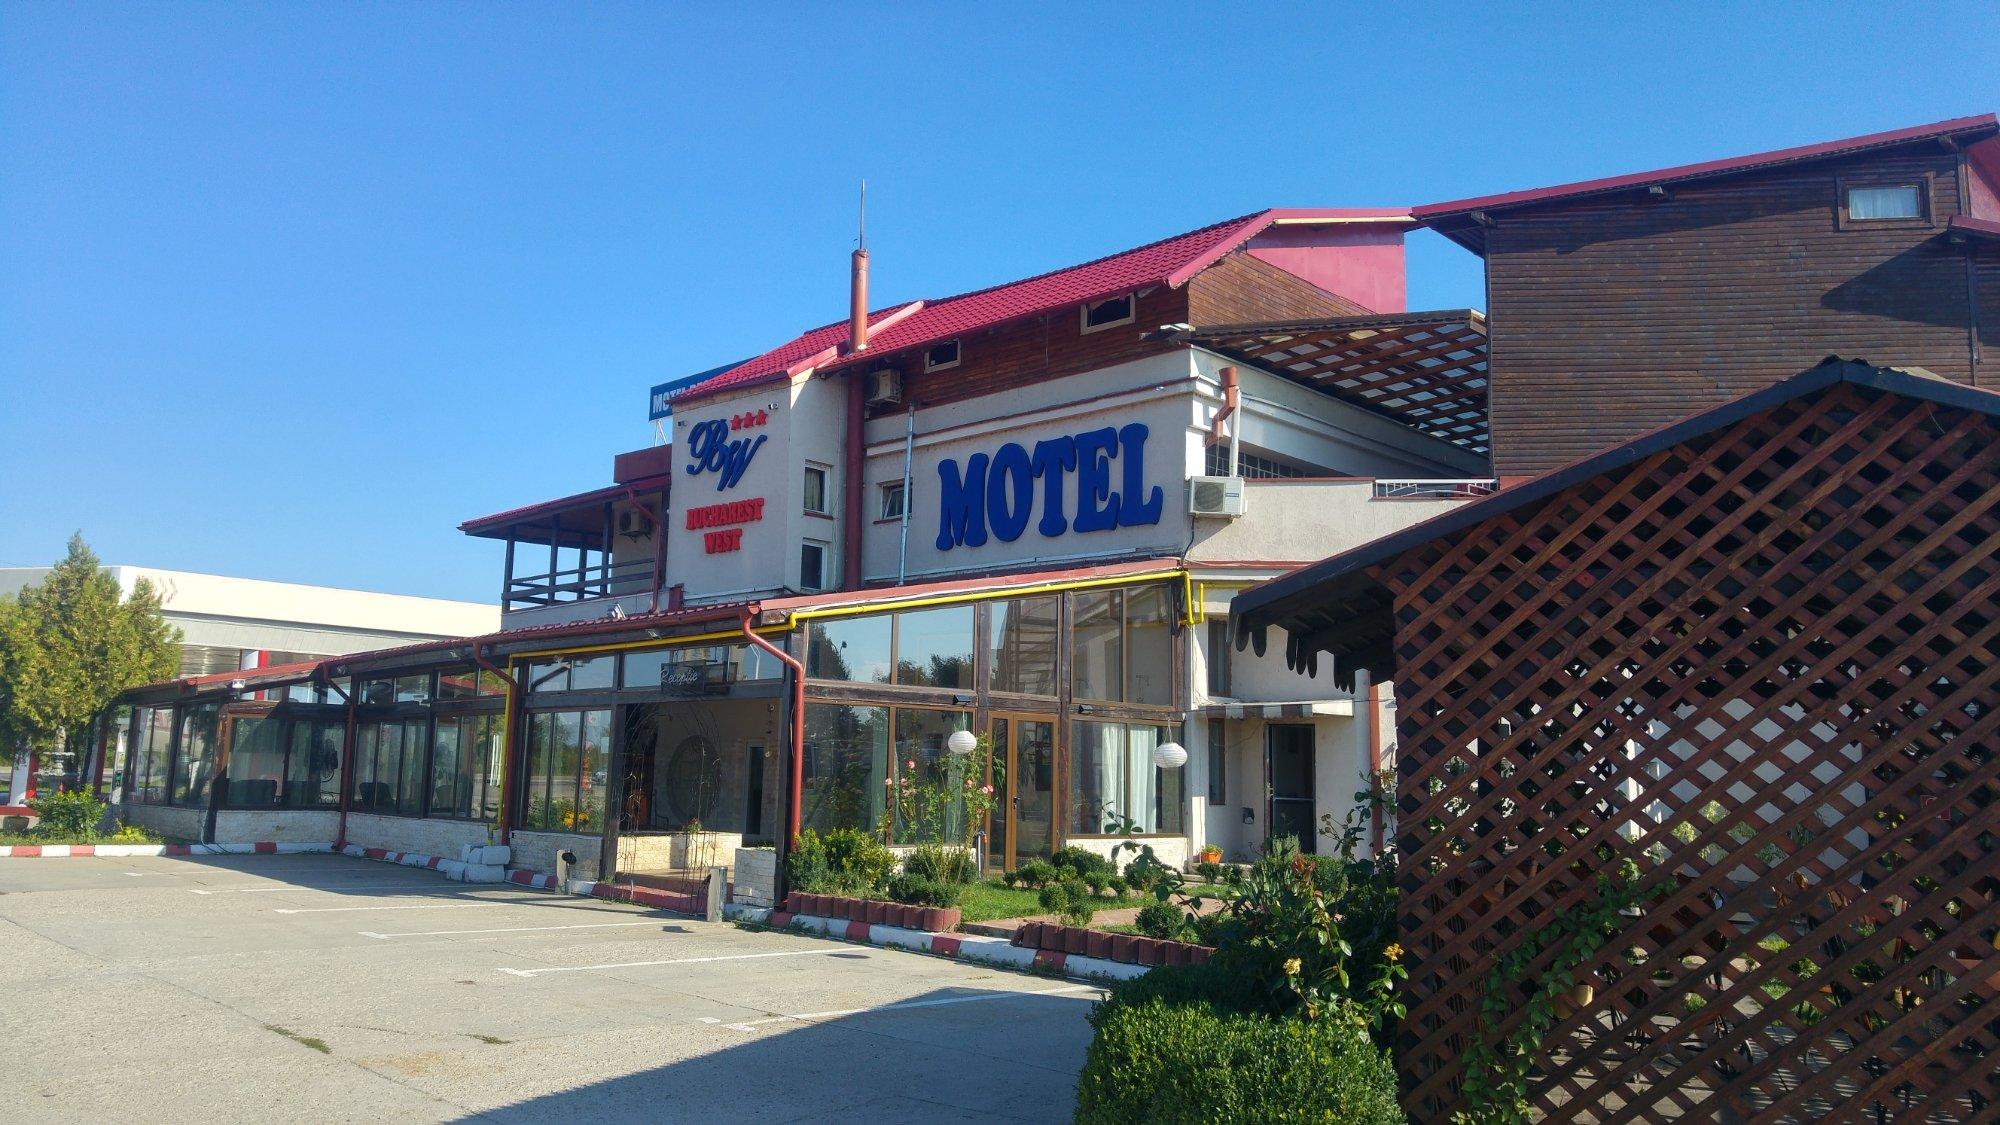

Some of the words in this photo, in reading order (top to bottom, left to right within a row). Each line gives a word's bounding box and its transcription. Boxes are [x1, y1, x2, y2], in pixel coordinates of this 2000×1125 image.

[936, 423, 1163, 550] MOTEL
[686, 497, 764, 530] BUCHAREST
[704, 528, 742, 554] WEST
